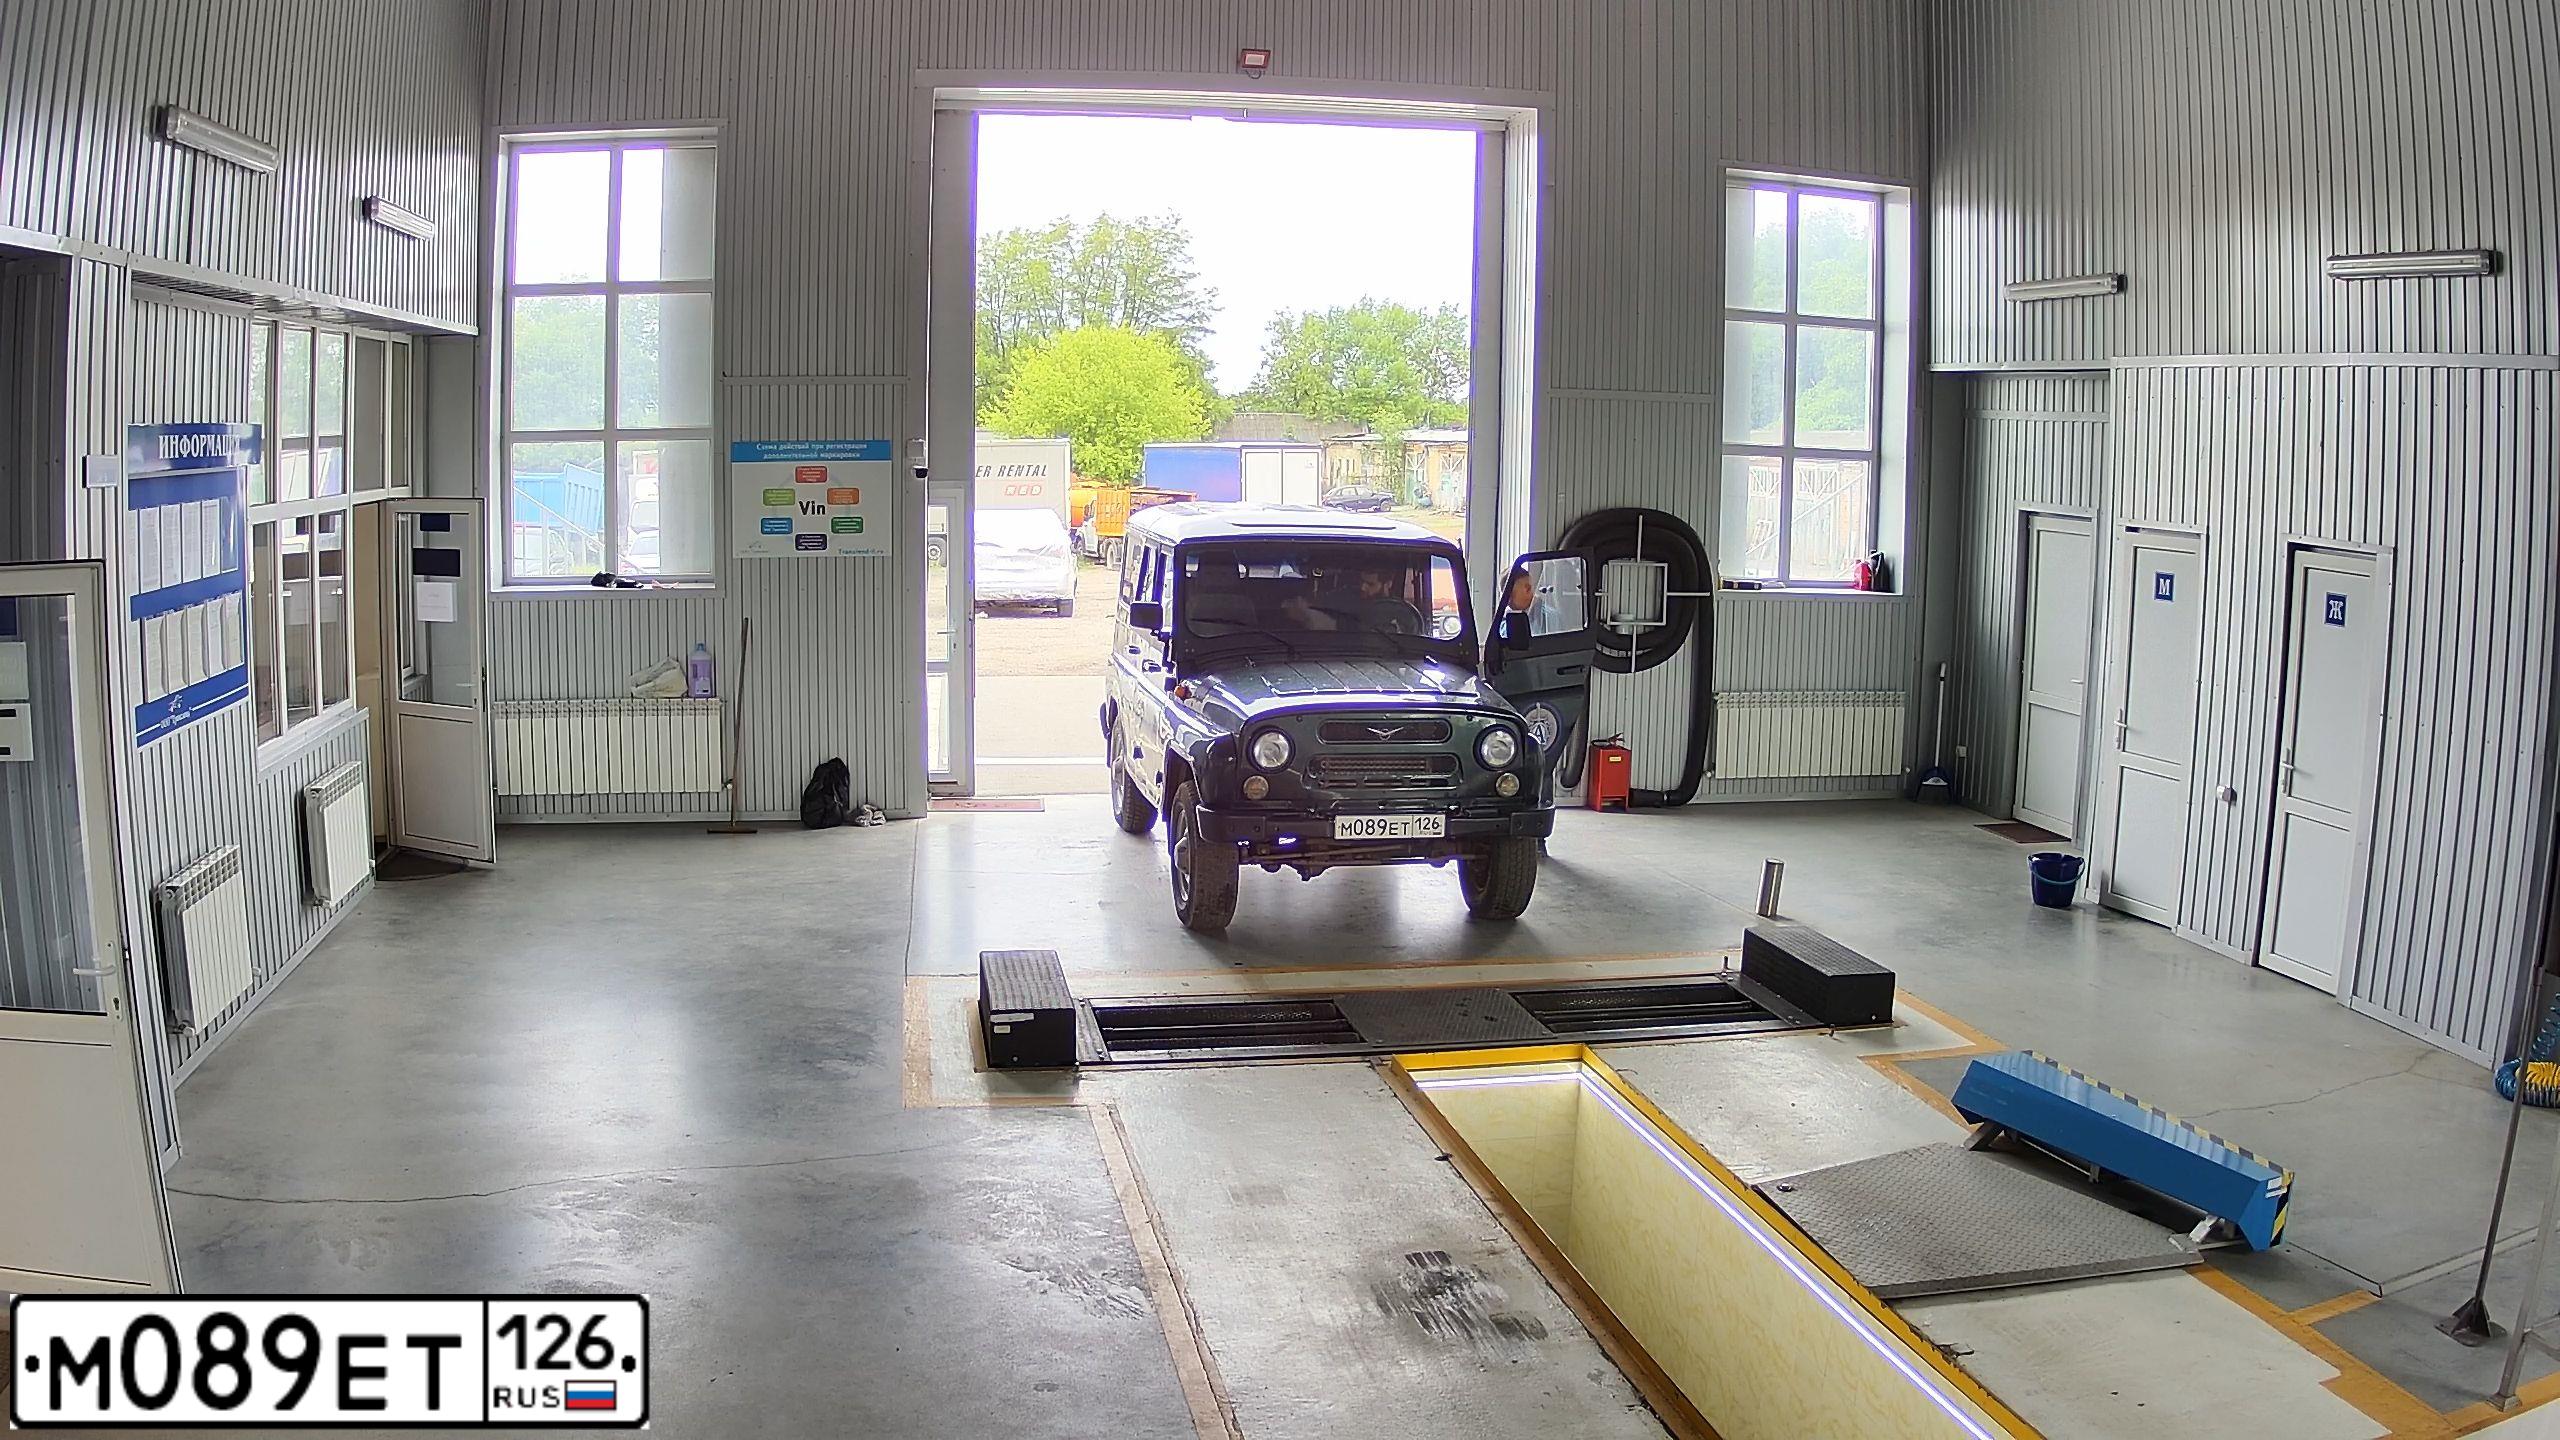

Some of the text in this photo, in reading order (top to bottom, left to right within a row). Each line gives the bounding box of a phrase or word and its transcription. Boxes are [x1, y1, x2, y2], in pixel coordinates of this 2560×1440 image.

[998, 465, 1047, 477] RENTAL
[799, 501, 826, 515] Vin
[2159, 578, 2171, 596] М
[2328, 600, 2343, 620] Ж
[1415, 817, 1440, 830] 126
